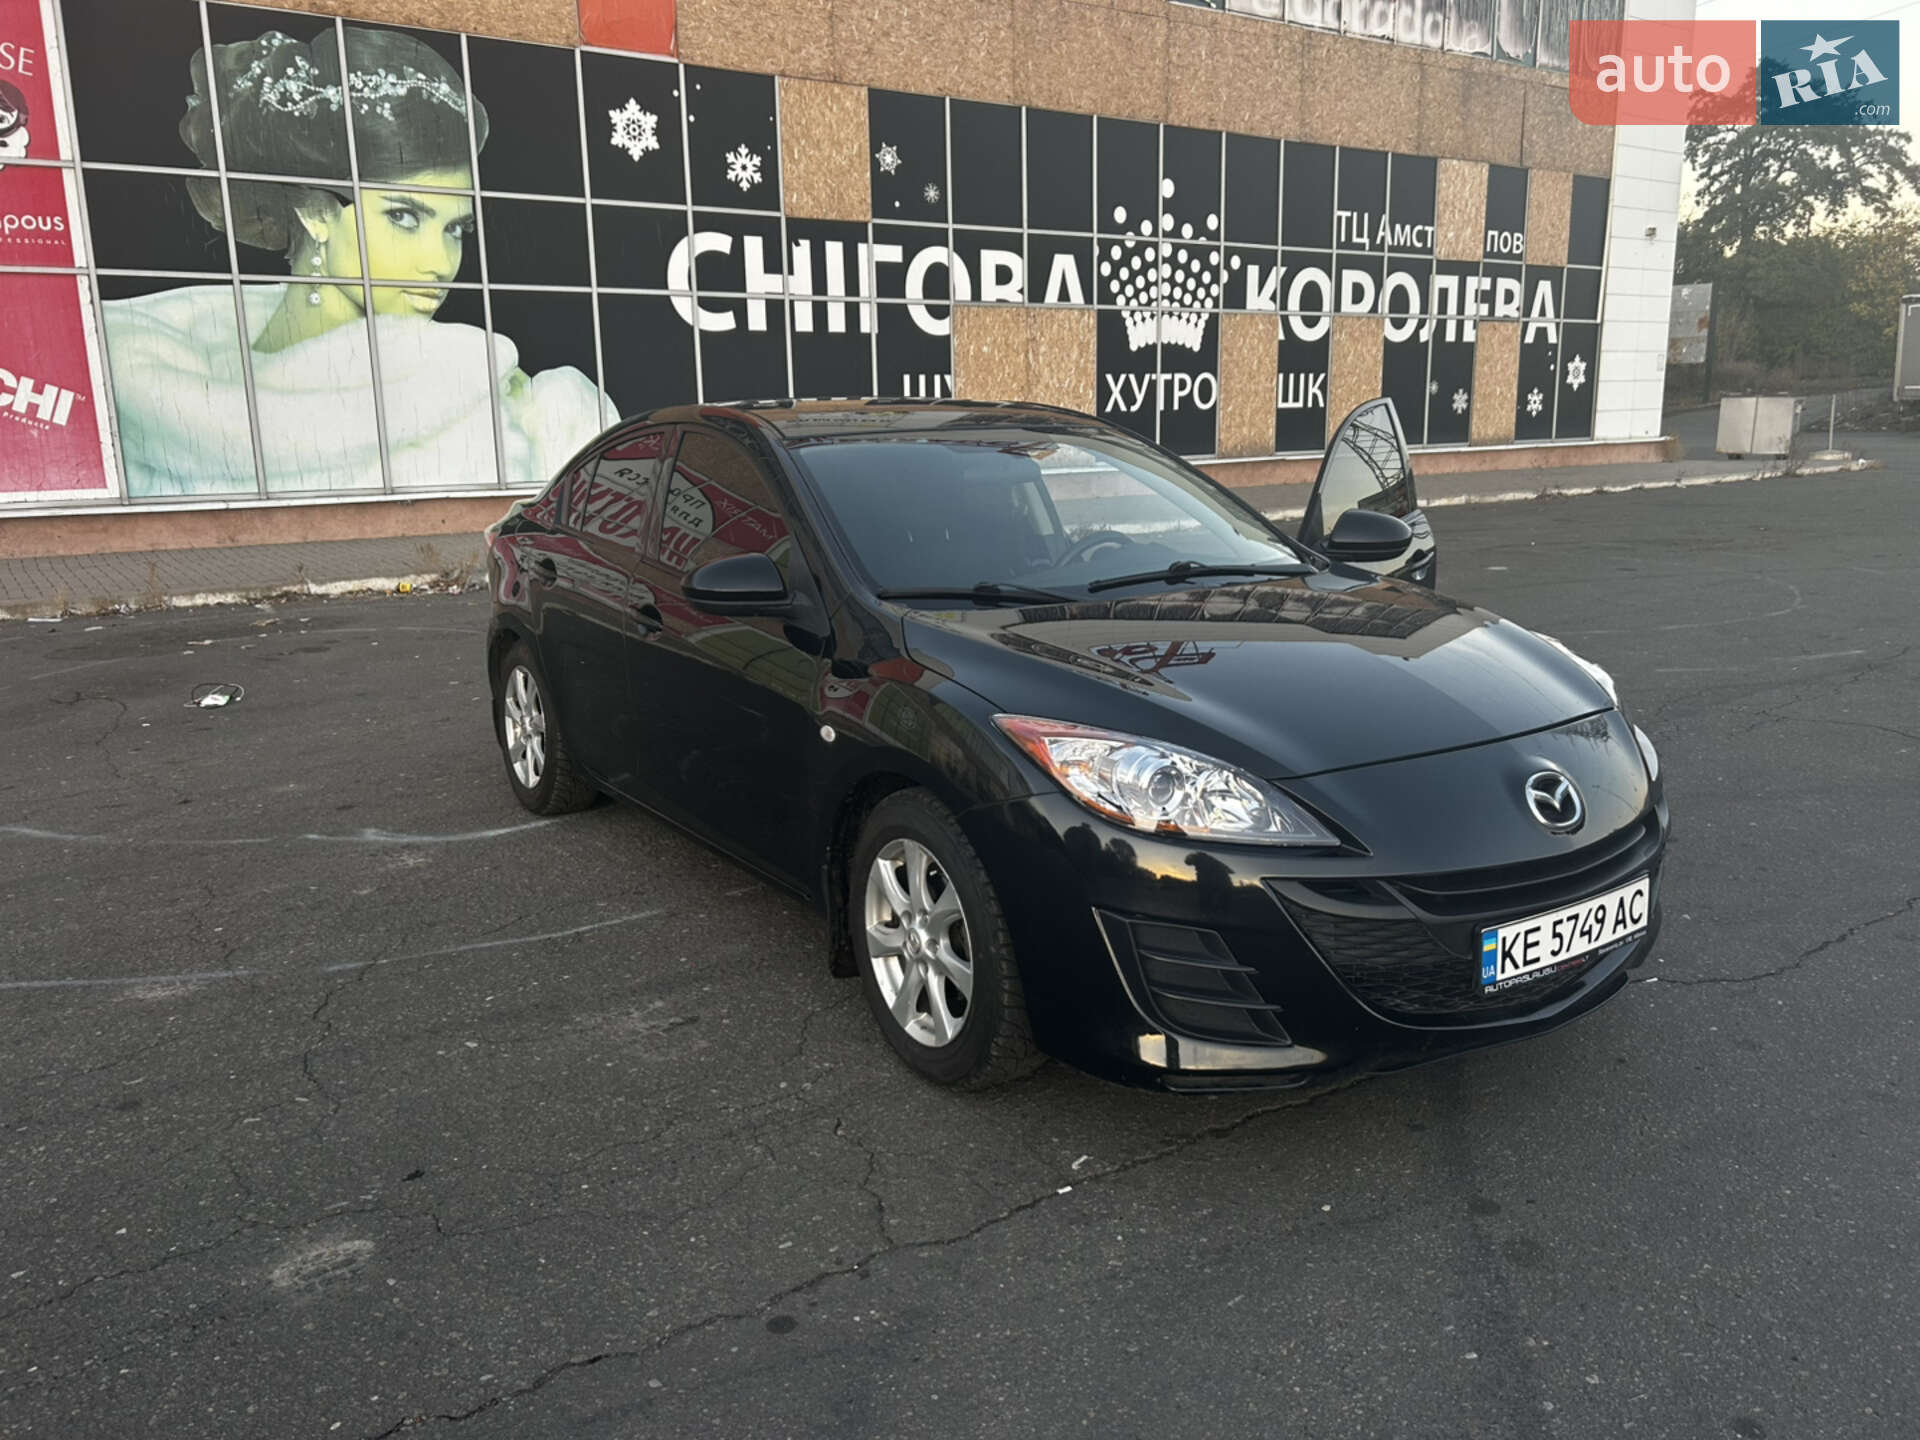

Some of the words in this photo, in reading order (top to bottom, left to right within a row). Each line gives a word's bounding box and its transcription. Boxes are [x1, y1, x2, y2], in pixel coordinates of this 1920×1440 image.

[0, 42, 34, 76] SE
[0, 214, 65, 235] pous
[1336, 210, 1370, 250] ТЦ
[666, 230, 1086, 336] СНІГОВА
[1245, 264, 1558, 344] КОРОЛЕВА
[1104, 371, 1218, 412] ХУТРО
[1277, 372, 1326, 409] ШК
[1500, 925, 1541, 975] KE
[1550, 903, 1607, 957] 5749
[1612, 888, 1644, 935] AC
[1482, 965, 1496, 979] UA
